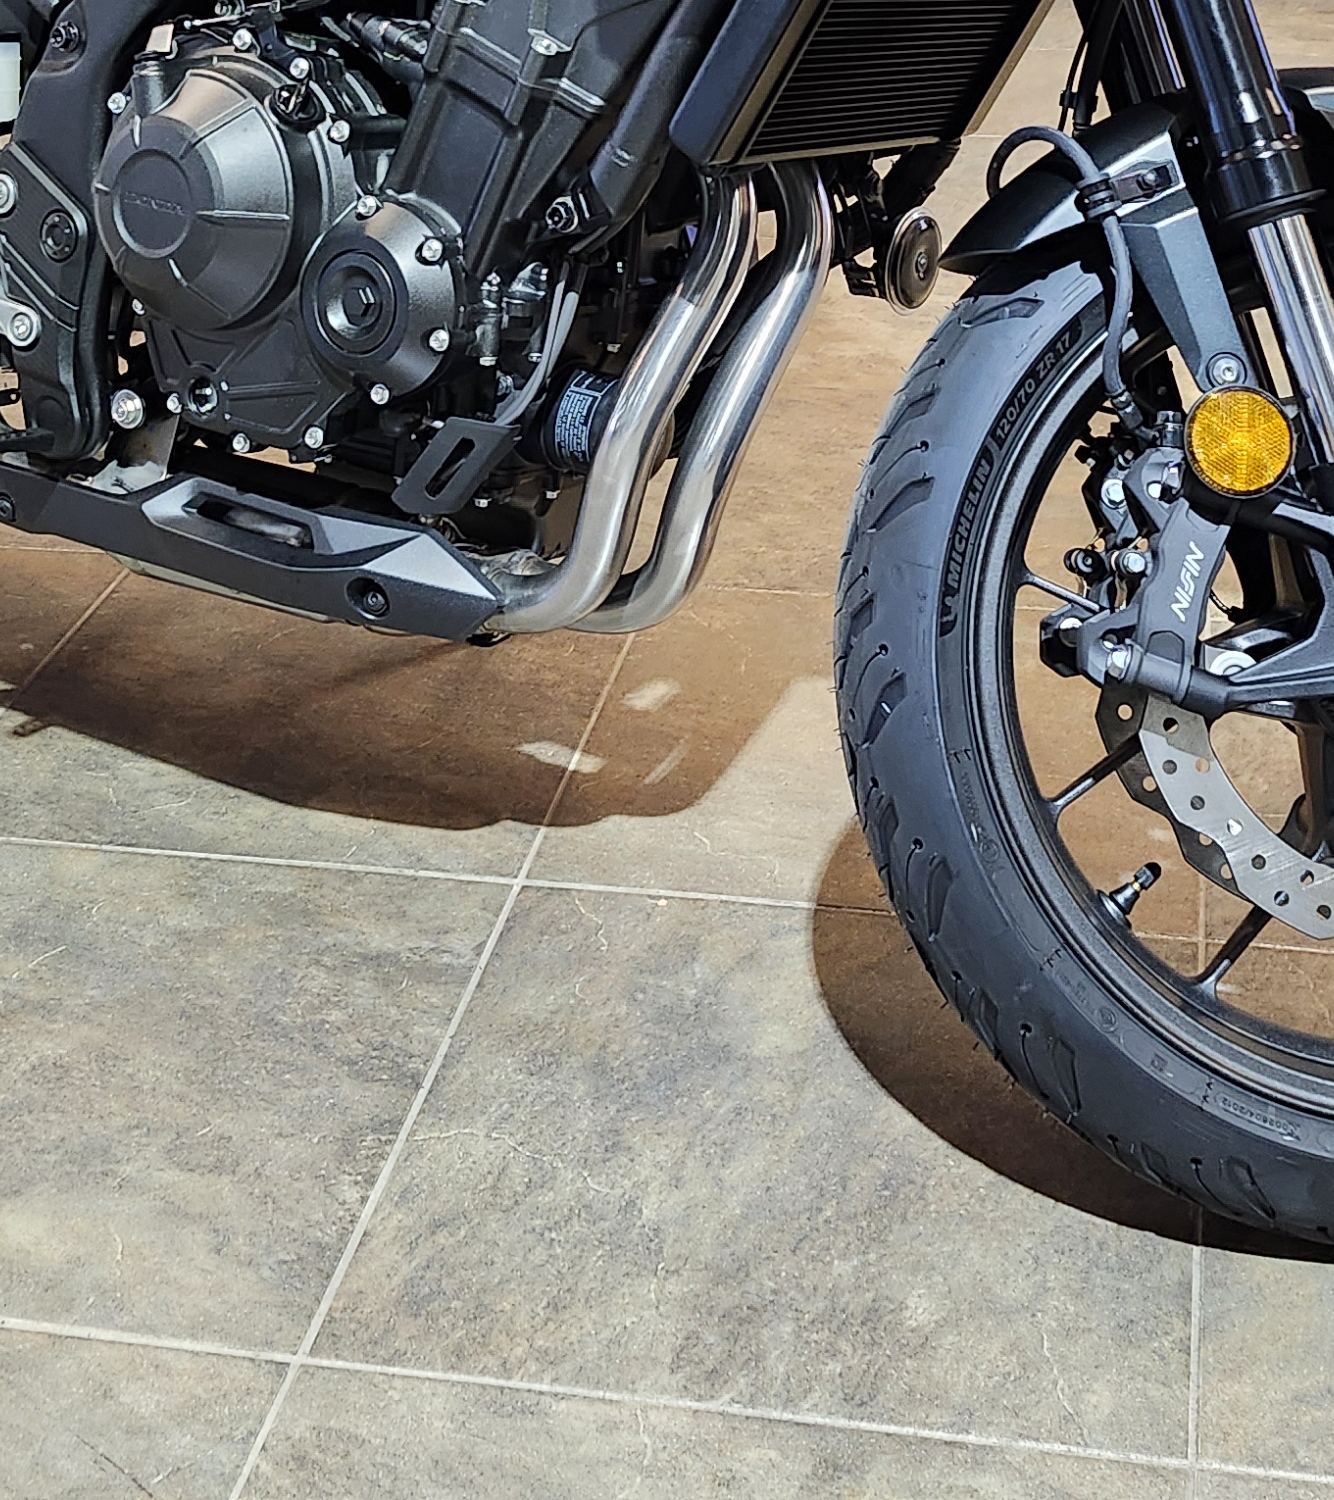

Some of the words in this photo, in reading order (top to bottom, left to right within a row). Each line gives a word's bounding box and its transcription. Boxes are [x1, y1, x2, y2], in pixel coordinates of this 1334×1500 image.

[947, 459, 991, 589] MICHELIN
[997, 379, 1035, 440] 120/70
[1036, 352, 1057, 380] ZR
[1057, 331, 1072, 355] 17
